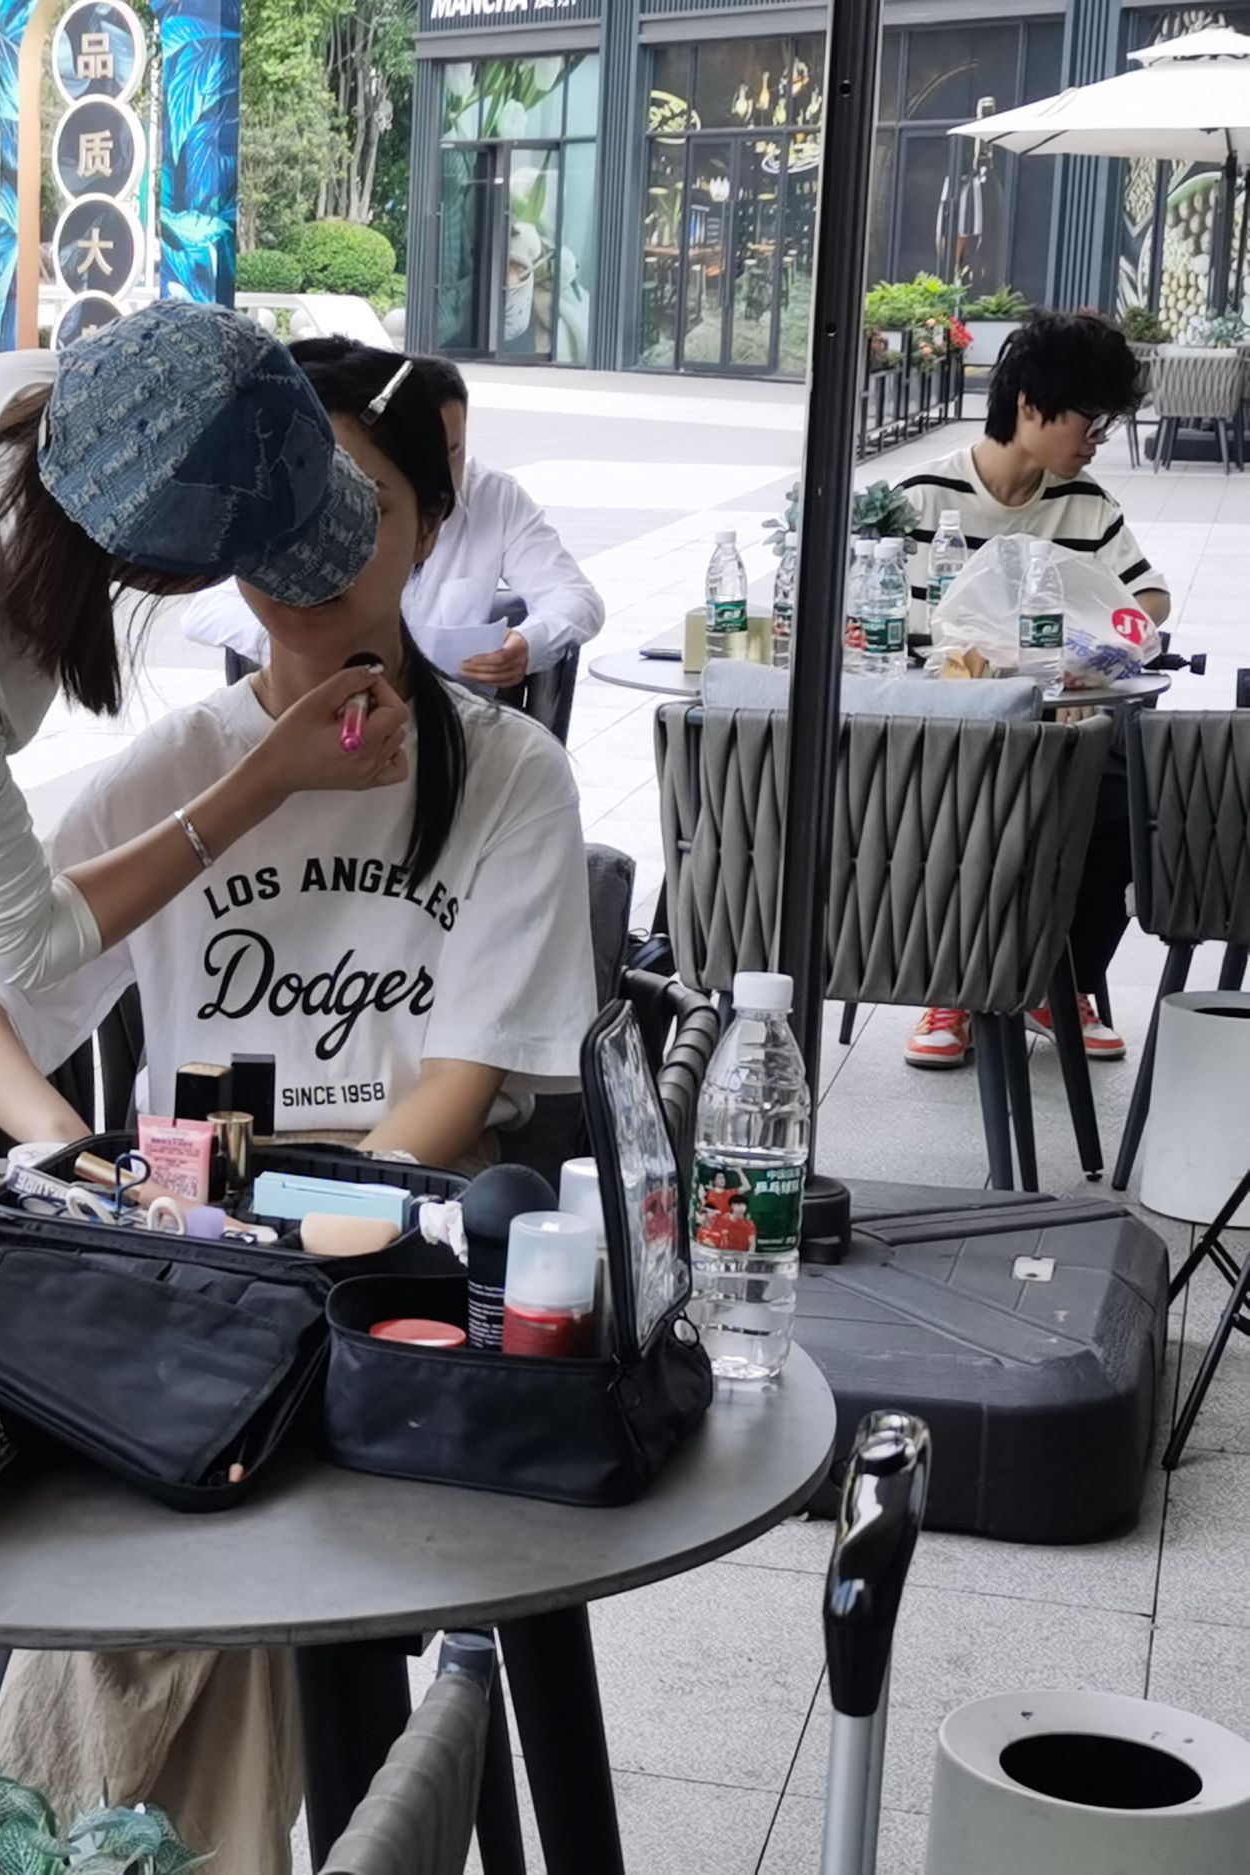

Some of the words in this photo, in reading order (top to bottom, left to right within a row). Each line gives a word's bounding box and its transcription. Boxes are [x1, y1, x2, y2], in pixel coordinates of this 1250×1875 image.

[203, 867, 281, 919] LOS
[300, 856, 459, 932] ANGELES
[197, 928, 436, 1060] Dodger
[282, 1085, 337, 1107] SINCE
[342, 1082, 385, 1104] 1958
